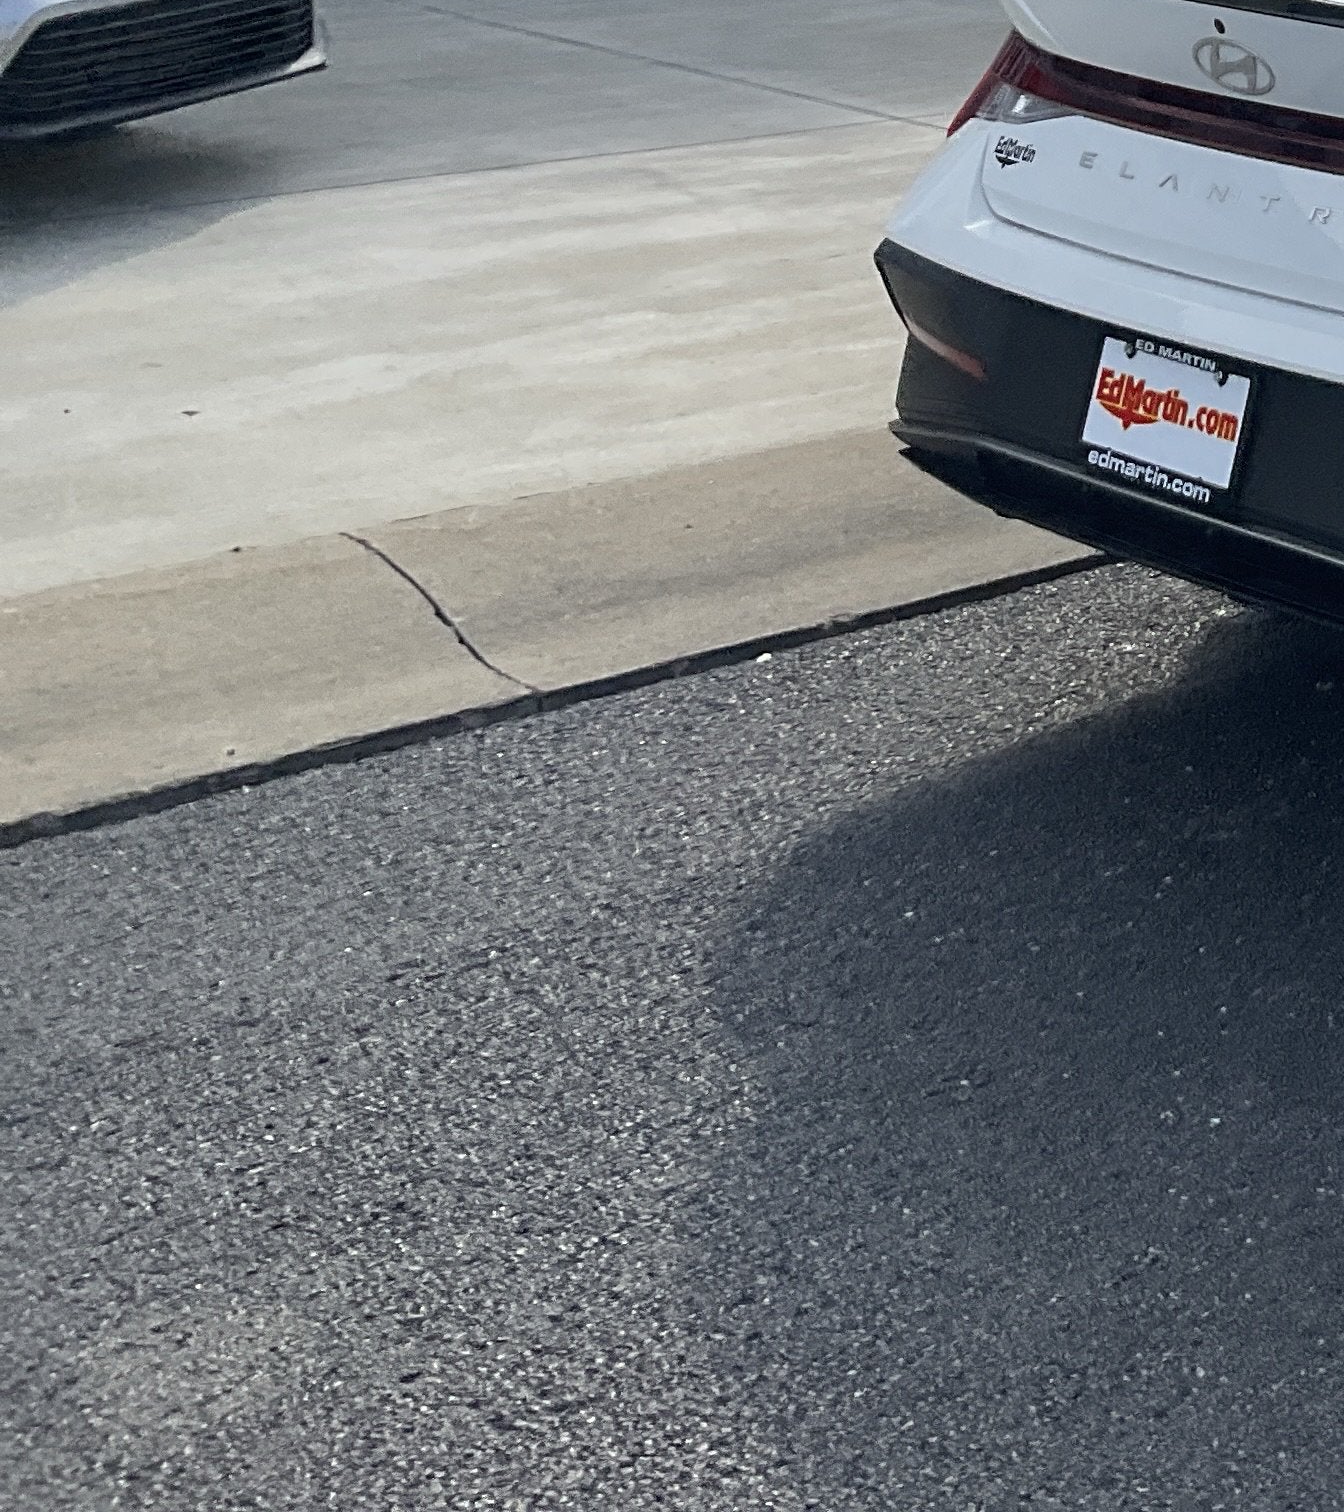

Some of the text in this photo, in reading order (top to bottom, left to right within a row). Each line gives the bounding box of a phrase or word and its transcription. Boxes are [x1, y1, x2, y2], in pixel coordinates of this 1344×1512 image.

[1135, 339, 1217, 372] ED MARTIN
[1095, 366, 1239, 442] EdMartin.com
[1087, 449, 1211, 503] edmartin.com
